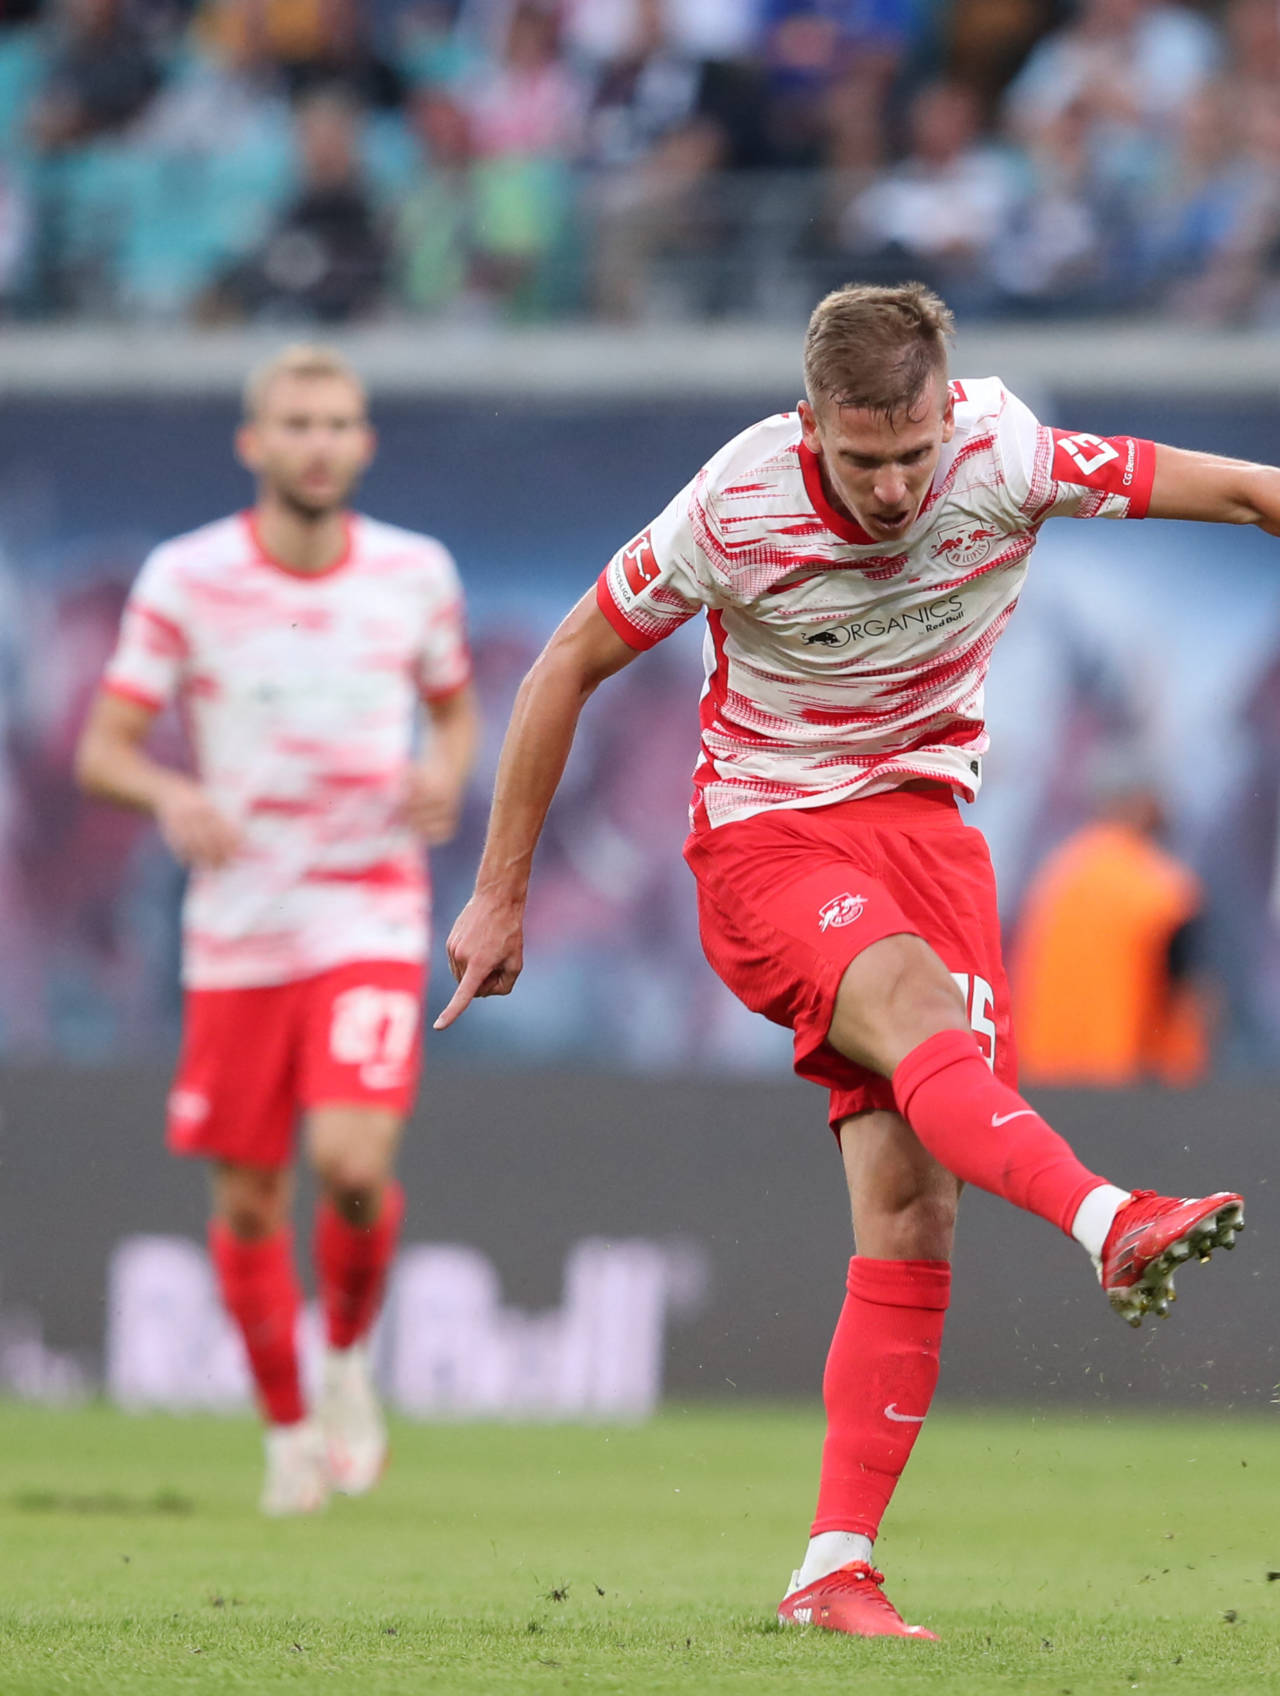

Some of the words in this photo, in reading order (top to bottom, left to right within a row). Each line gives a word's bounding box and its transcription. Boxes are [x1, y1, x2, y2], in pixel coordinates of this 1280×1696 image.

[823, 594, 963, 648] ORGANICS
[925, 619, 945, 633] Red
[946, 612, 964, 626] Bull
